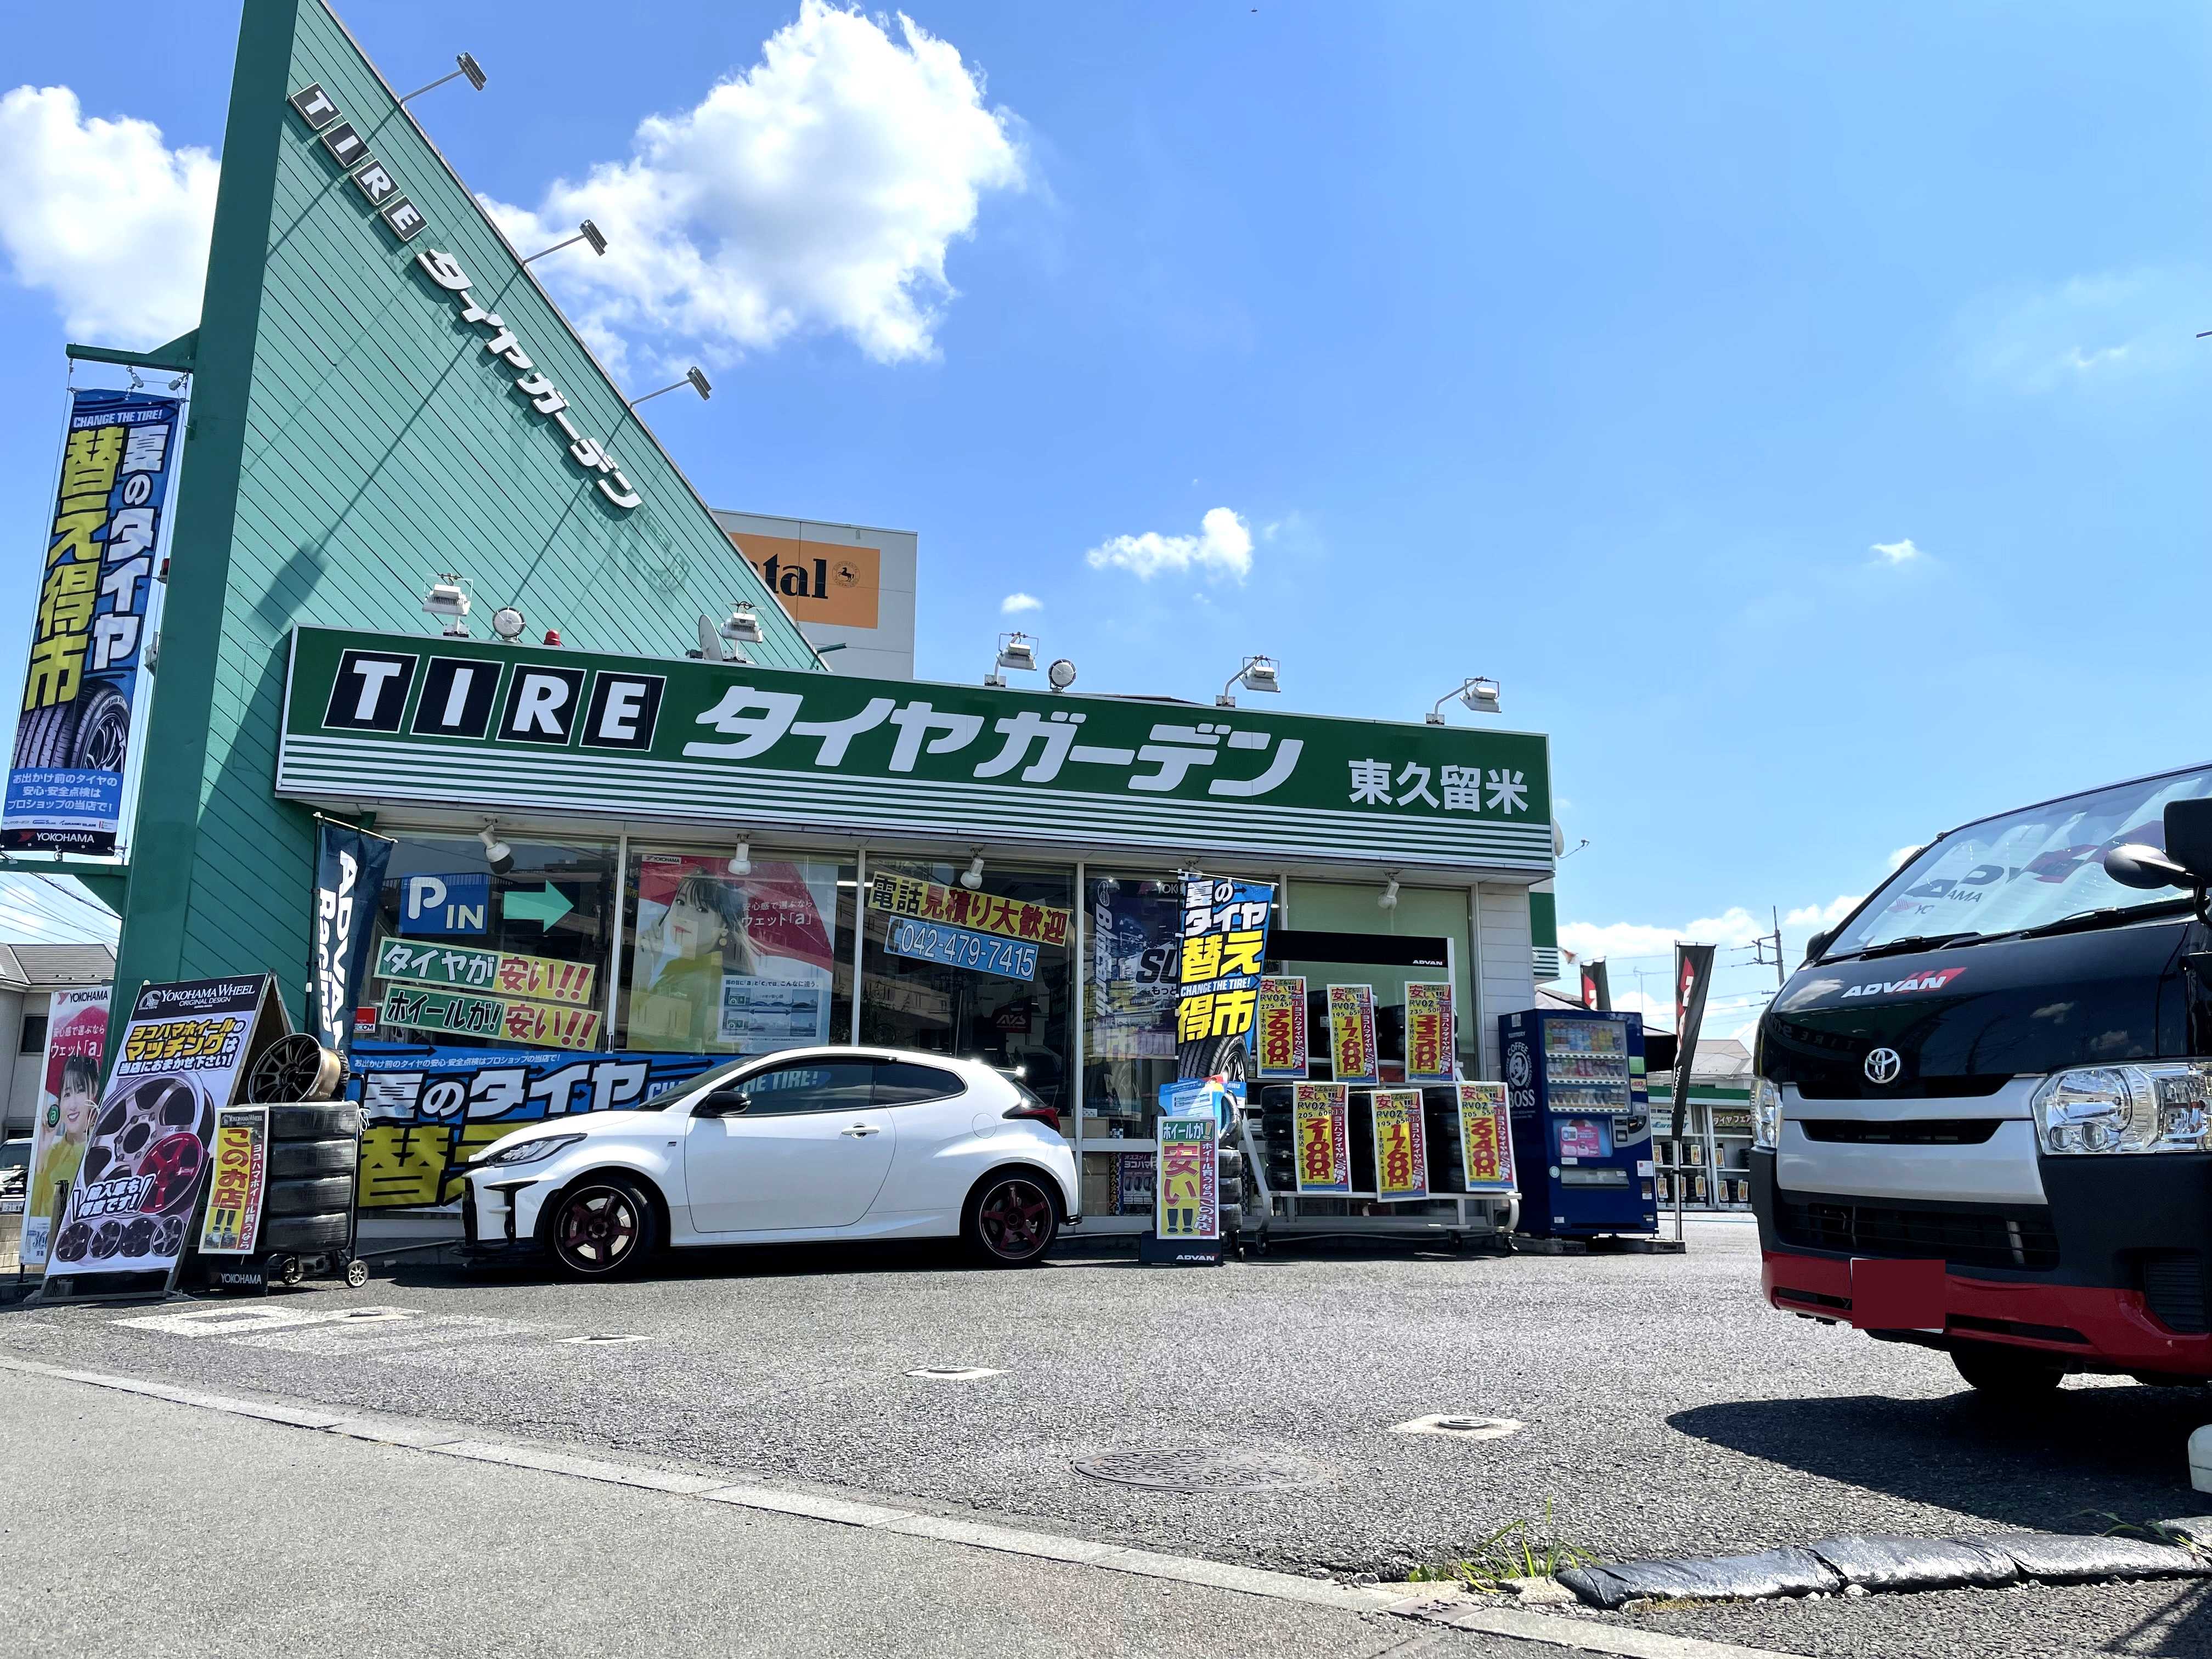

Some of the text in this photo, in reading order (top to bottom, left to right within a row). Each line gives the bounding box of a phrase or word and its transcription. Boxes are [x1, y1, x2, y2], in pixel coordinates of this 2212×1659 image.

[303, 90, 420, 231] TIRE
[416, 249, 642, 508] タイヤガーデン
[74, 409, 163, 428] CHANGE THE TIRE!
[25, 426, 126, 712] 替え得市
[93, 425, 169, 670] 夏のタイヤ
[749, 553, 828, 599] tal
[353, 660, 646, 740] TIRE
[682, 685, 1304, 797] タイヤガーデン
[13, 772, 117, 787] お出かけ前のタイヤの
[1348, 758, 1528, 815] 東久留米
[36, 832, 94, 843] YOKOHAMA
[408, 877, 484, 929] P IN
[742, 900, 813, 911] 安心感で選ぶなら
[872, 877, 1068, 945] 電話見積り大歓迎
[901, 924, 1035, 977] 042-479-7415
[70, 990, 108, 1003] YOKOHAMA
[161, 984, 255, 1002] YOKOHAMA WHEEL
[179, 999, 208, 1007] ORIGINAL
[1181, 977, 1251, 997] CHANGE THE TIRE!
[1841, 976, 1947, 998] ADVAN
[131, 1018, 246, 1041] ヨコハマホイールの
[1178, 990, 1258, 1043] 得市
[119, 1054, 233, 1075] 当店におまかせ下さい!
[127, 1033, 239, 1061] マッチングは
[1508, 1042, 1529, 1056] COFFEE
[364, 1062, 647, 1119] 夏のタイヤ
[1509, 1089, 1536, 1108] BOSS
[211, 1128, 250, 1210] このお店
[1164, 1142, 1199, 1206] 安い
[240, 1143, 262, 1250] ヨコハマホイール買うなら
[221, 1273, 262, 1285] YOKOHAMA
